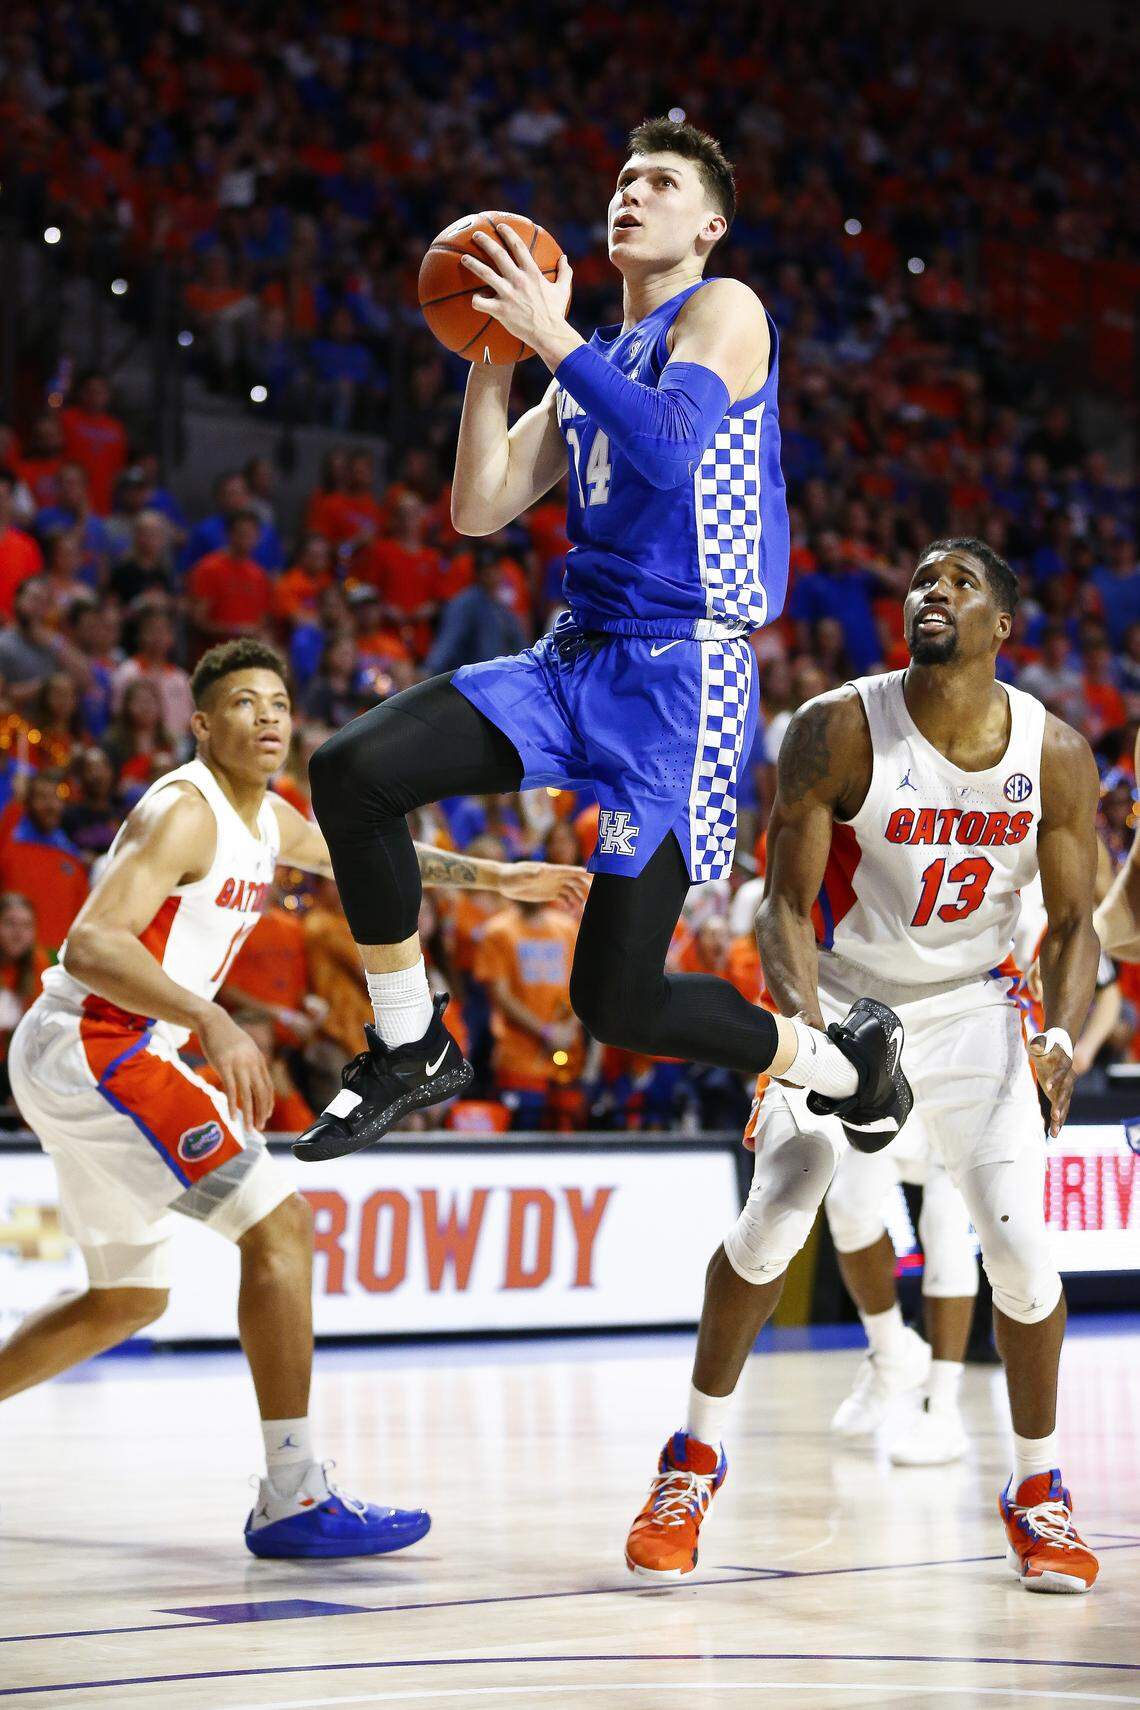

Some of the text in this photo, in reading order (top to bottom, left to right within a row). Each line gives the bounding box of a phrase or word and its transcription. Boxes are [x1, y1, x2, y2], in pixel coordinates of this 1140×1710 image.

[566, 427, 611, 508] 14
[1005, 774, 1031, 801] SEC
[600, 811, 639, 856] UK
[885, 808, 1034, 845] GATORS
[911, 857, 994, 926] 13
[1044, 1155, 1137, 1231] RIV
[299, 1186, 615, 1295] ROWDY
